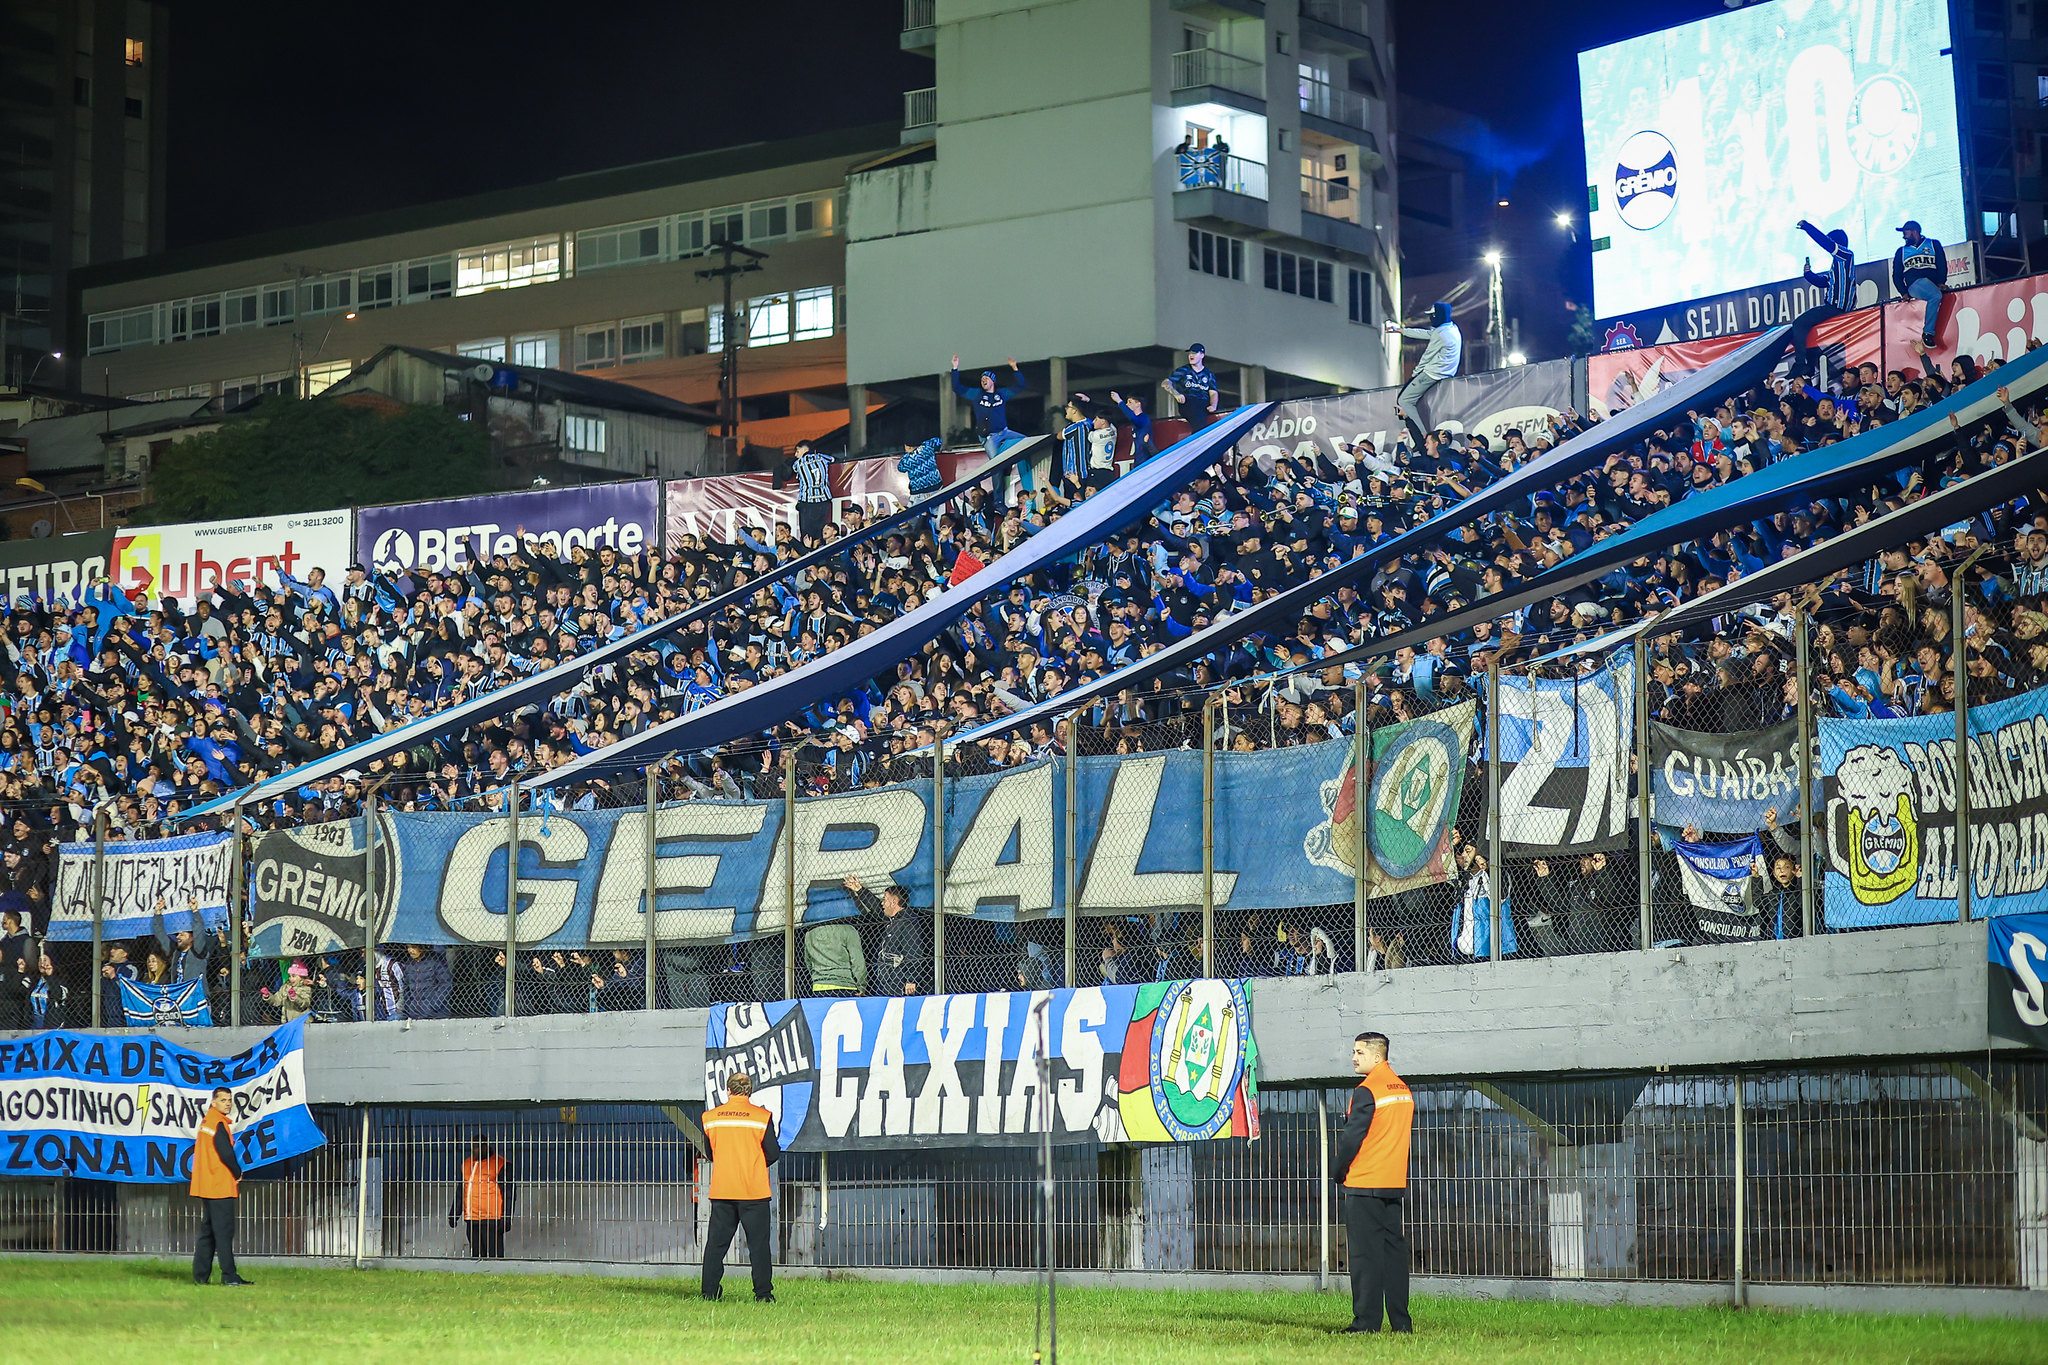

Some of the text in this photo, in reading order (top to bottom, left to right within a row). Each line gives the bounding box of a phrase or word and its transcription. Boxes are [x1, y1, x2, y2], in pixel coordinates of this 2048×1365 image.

[1686, 284, 1826, 340] SEJA DOADO
[1251, 415, 1317, 442] RÁDIO
[1105, 441, 1114, 461] 9
[194, 523, 273, 537] WWW.GUBERT.NET.BR
[303, 516, 344, 528] 3211.3200
[313, 825, 346, 847] 1903
[1864, 836, 1904, 851] GRÊMIO
[437, 754, 1240, 945] GERAL
[255, 858, 379, 928] GRÊMIO
[287, 928, 318, 954] FBPA
[1698, 919, 1747, 937] CONSULADO
[0, 1036, 280, 1084] FAIXA DE GAZA
[818, 983, 1109, 1138] CAXIAS
[1152, 1053, 1159, 1072] 20
[1153, 1076, 1162, 1095] DE
[151, 1092, 208, 1129] SANT
[1215, 1095, 1235, 1126] 1835
[6, 1135, 133, 1177] ZONA
